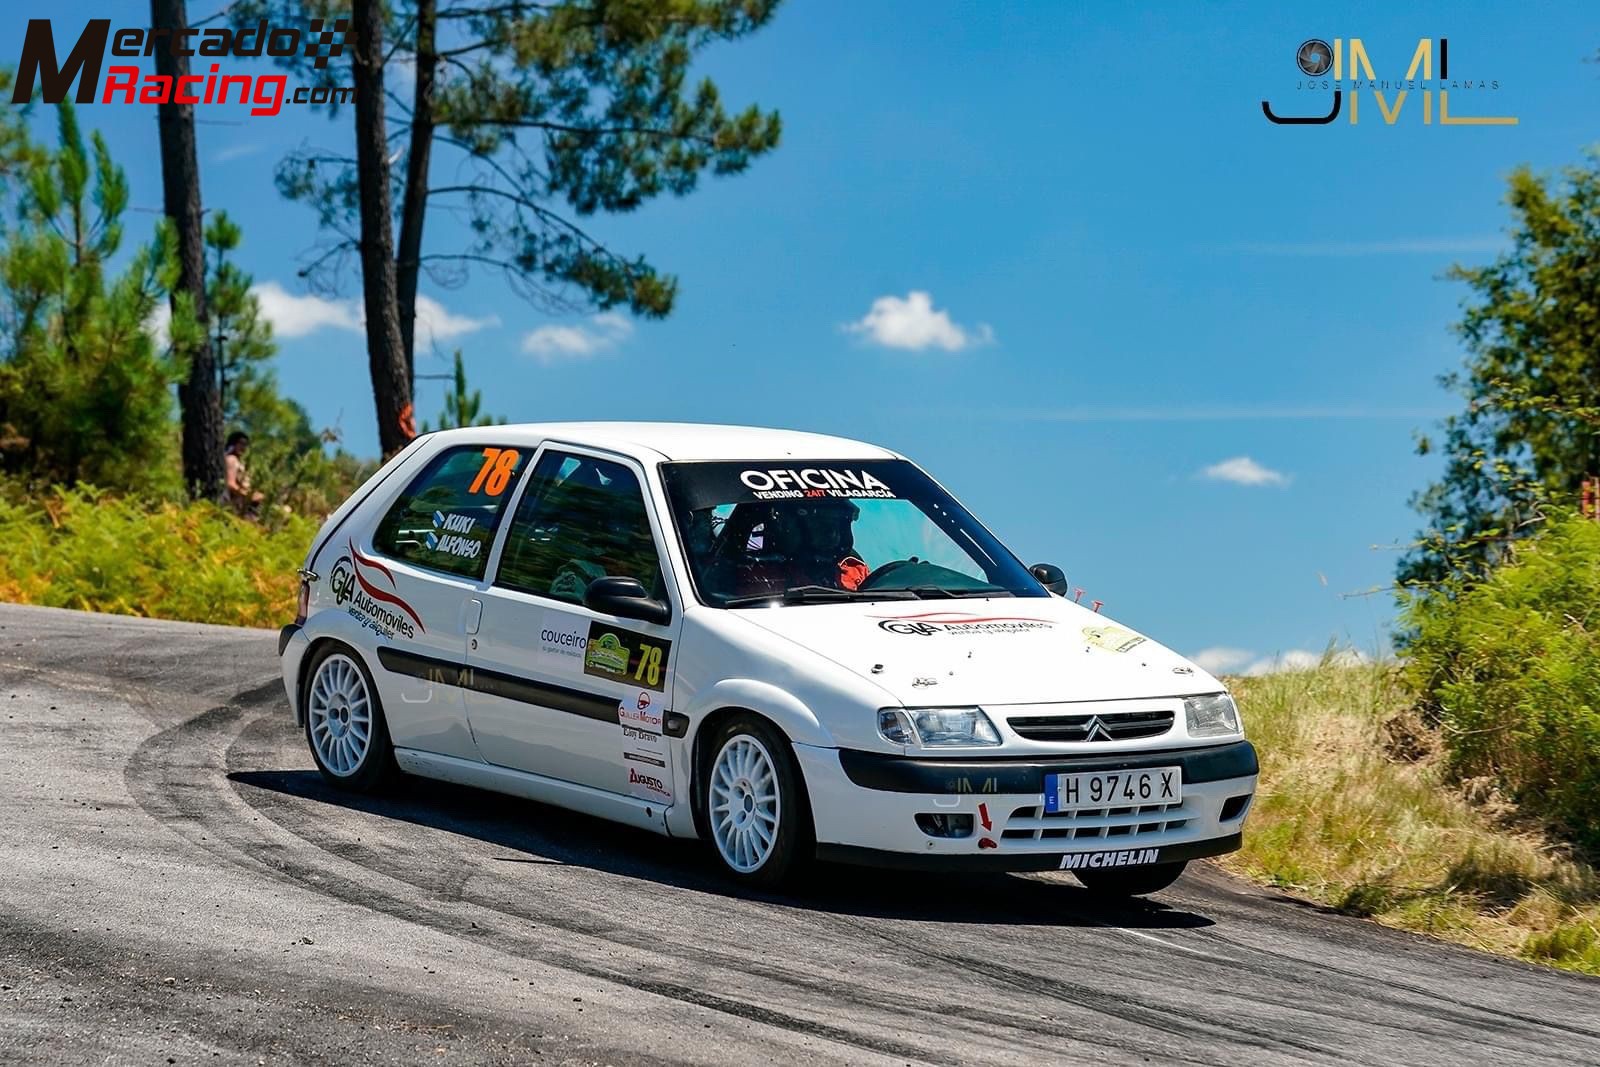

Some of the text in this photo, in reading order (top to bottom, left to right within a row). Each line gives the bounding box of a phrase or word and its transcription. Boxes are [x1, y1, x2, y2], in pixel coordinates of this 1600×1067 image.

[469, 448, 520, 497] 78
[740, 469, 891, 491] OFICINA
[753, 491, 803, 500] VENDING
[804, 489, 827, 498] 24/7
[443, 513, 477, 534] KUKI
[436, 534, 482, 559] ALFONSO
[348, 606, 366, 622] venta
[362, 617, 371, 628] y
[354, 590, 414, 639] Automóviles
[541, 629, 587, 649] couceiro
[634, 643, 663, 686] 78
[630, 767, 663, 789] AUGUSTO
[1066, 771, 1173, 804] H 9746 X
[1059, 848, 1160, 870] MICHELIN
